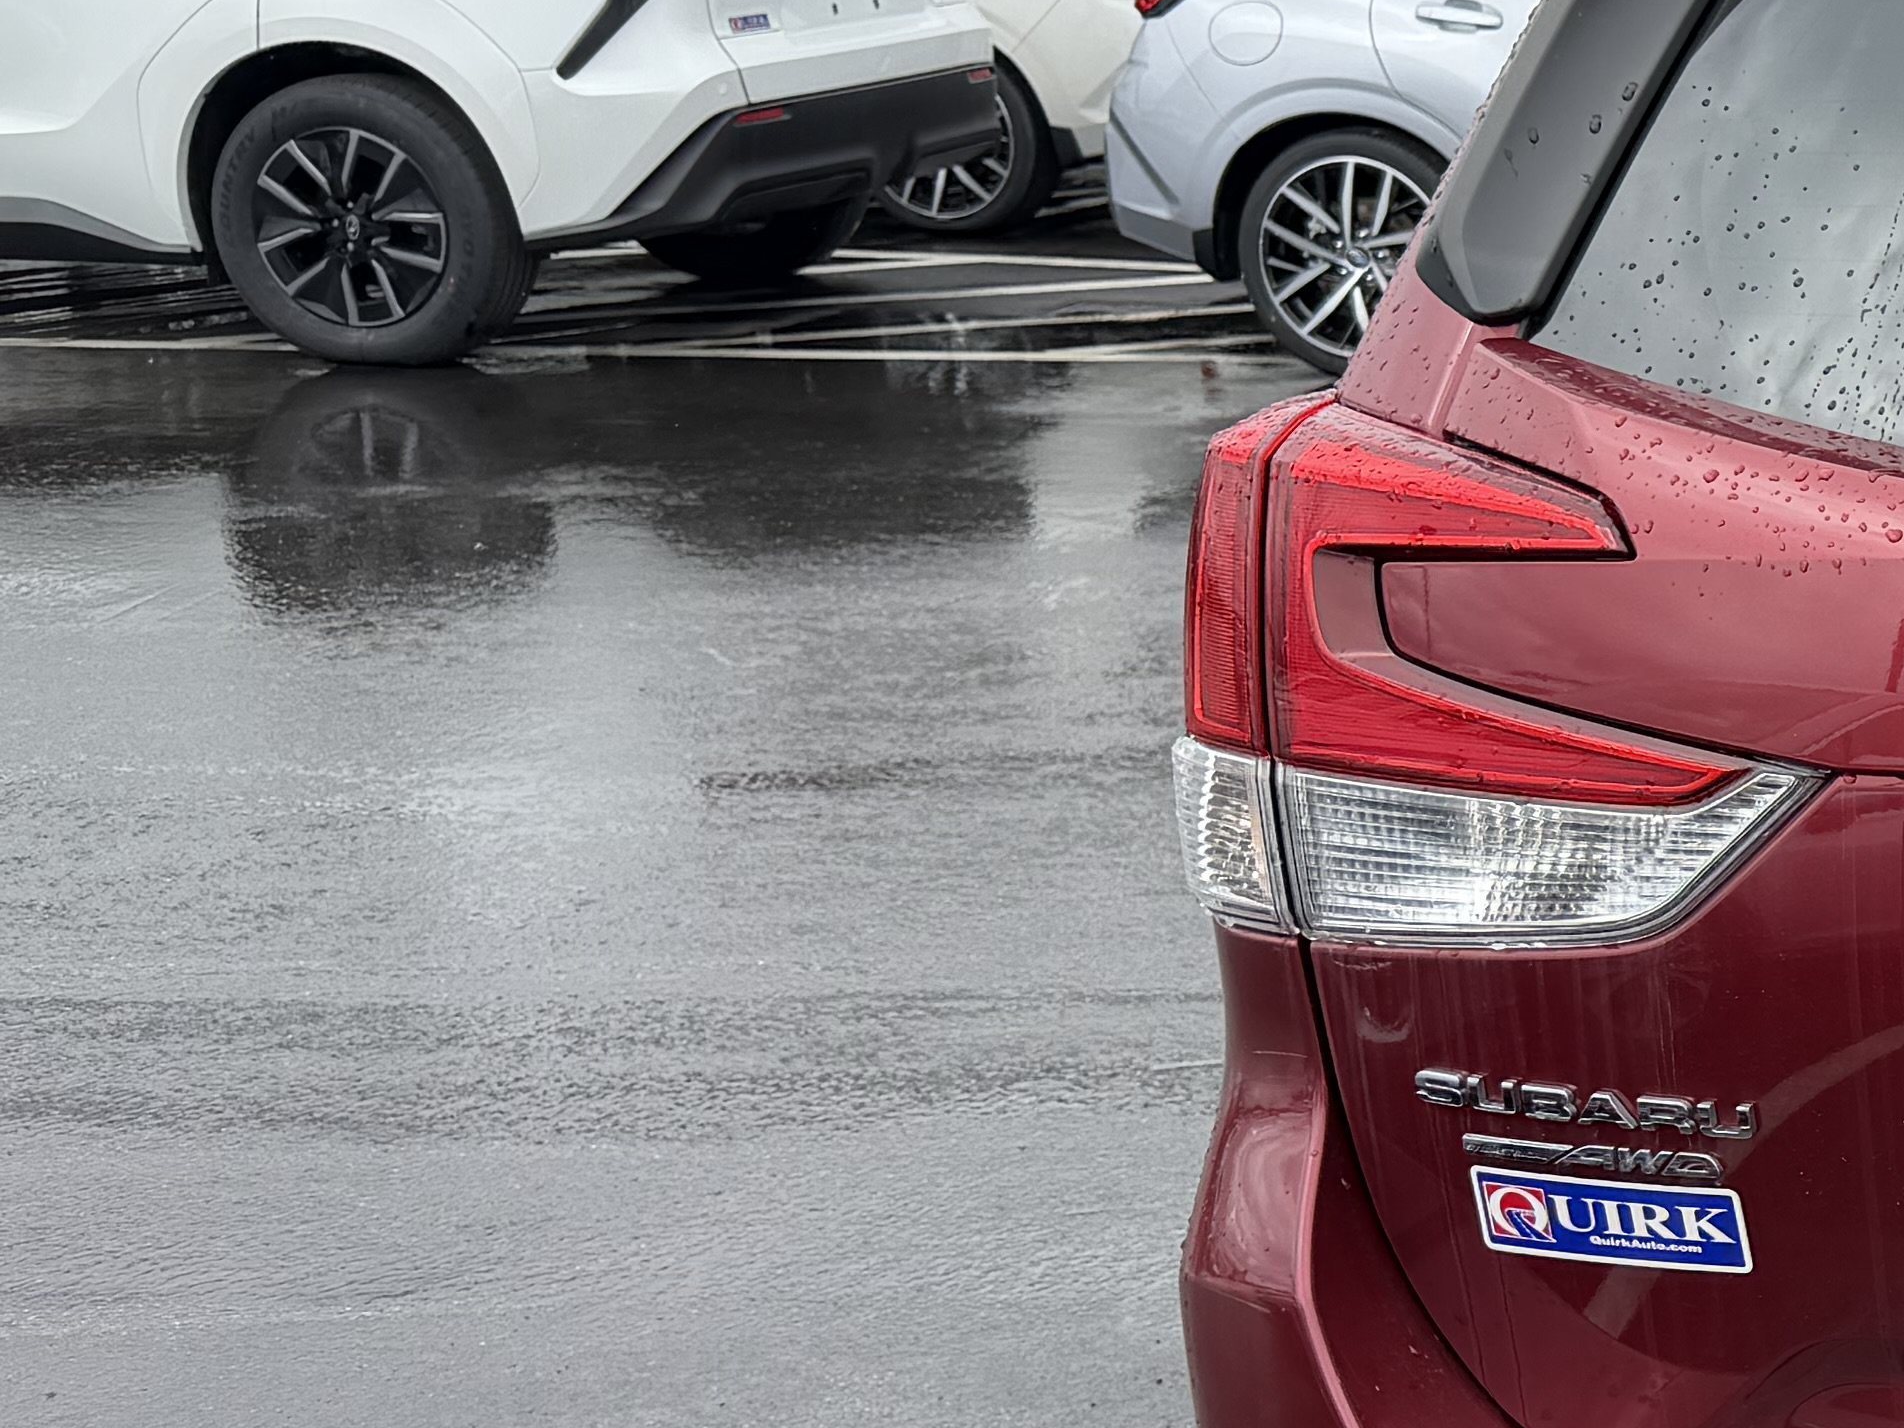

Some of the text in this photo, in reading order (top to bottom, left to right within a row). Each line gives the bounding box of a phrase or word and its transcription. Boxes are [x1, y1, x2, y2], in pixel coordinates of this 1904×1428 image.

[1415, 1068, 1757, 1139] SUBARU
[1555, 1145, 1723, 1180] AWD
[1488, 1186, 1737, 1244] QUIRK
[1589, 1235, 1703, 1254] QuirkAuto.com
